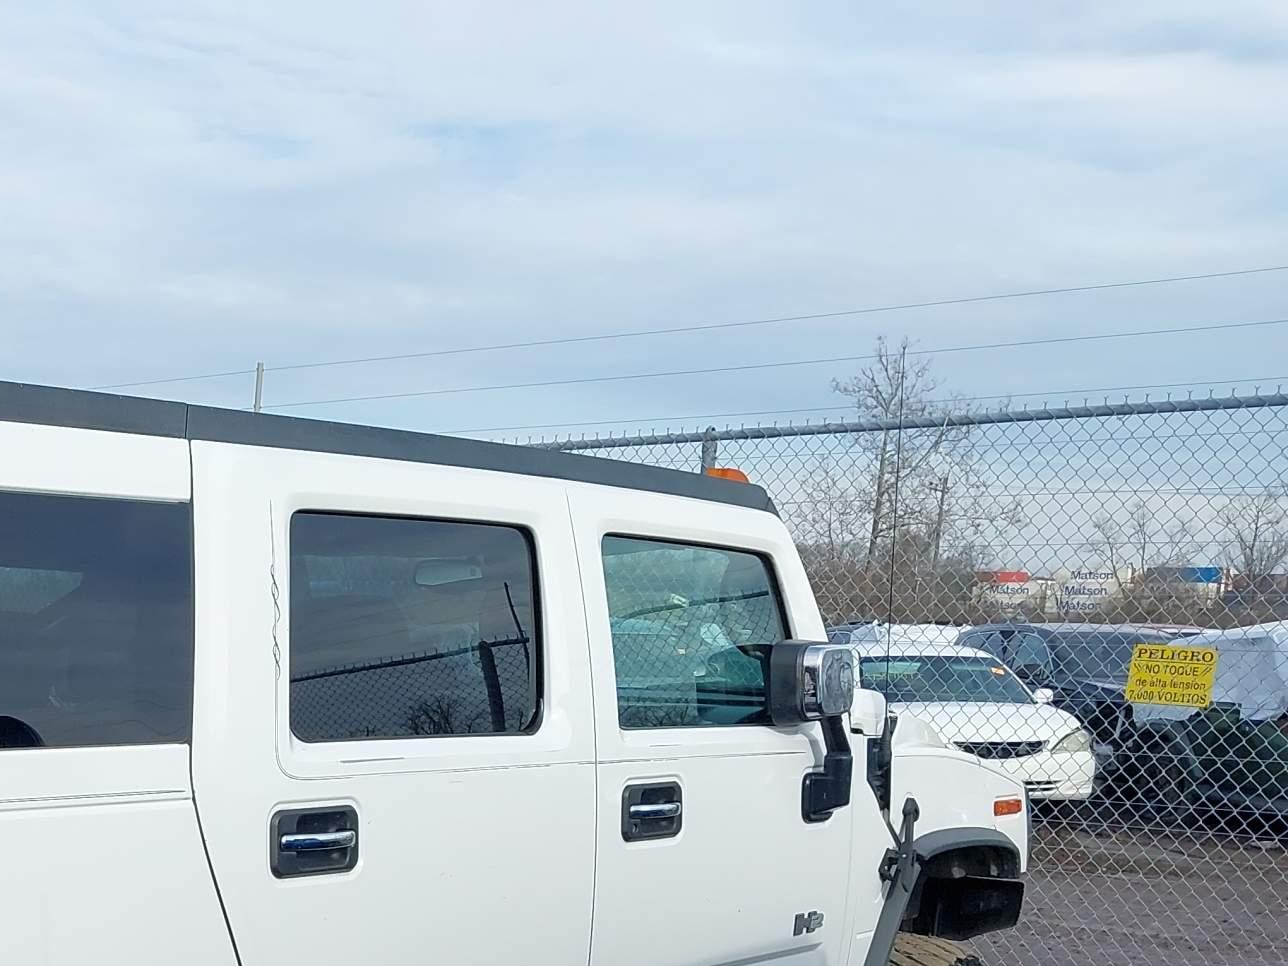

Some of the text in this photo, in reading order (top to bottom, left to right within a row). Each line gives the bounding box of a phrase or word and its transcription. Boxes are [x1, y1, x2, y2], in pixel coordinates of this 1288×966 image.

[1070, 570, 1114, 580] Matson
[1064, 585, 1108, 595] Matson
[1137, 648, 1214, 662] PELIGRO
[1145, 664, 1160, 674] NO
[1135, 678, 1147, 687] de
[1149, 678, 1167, 688] alta
